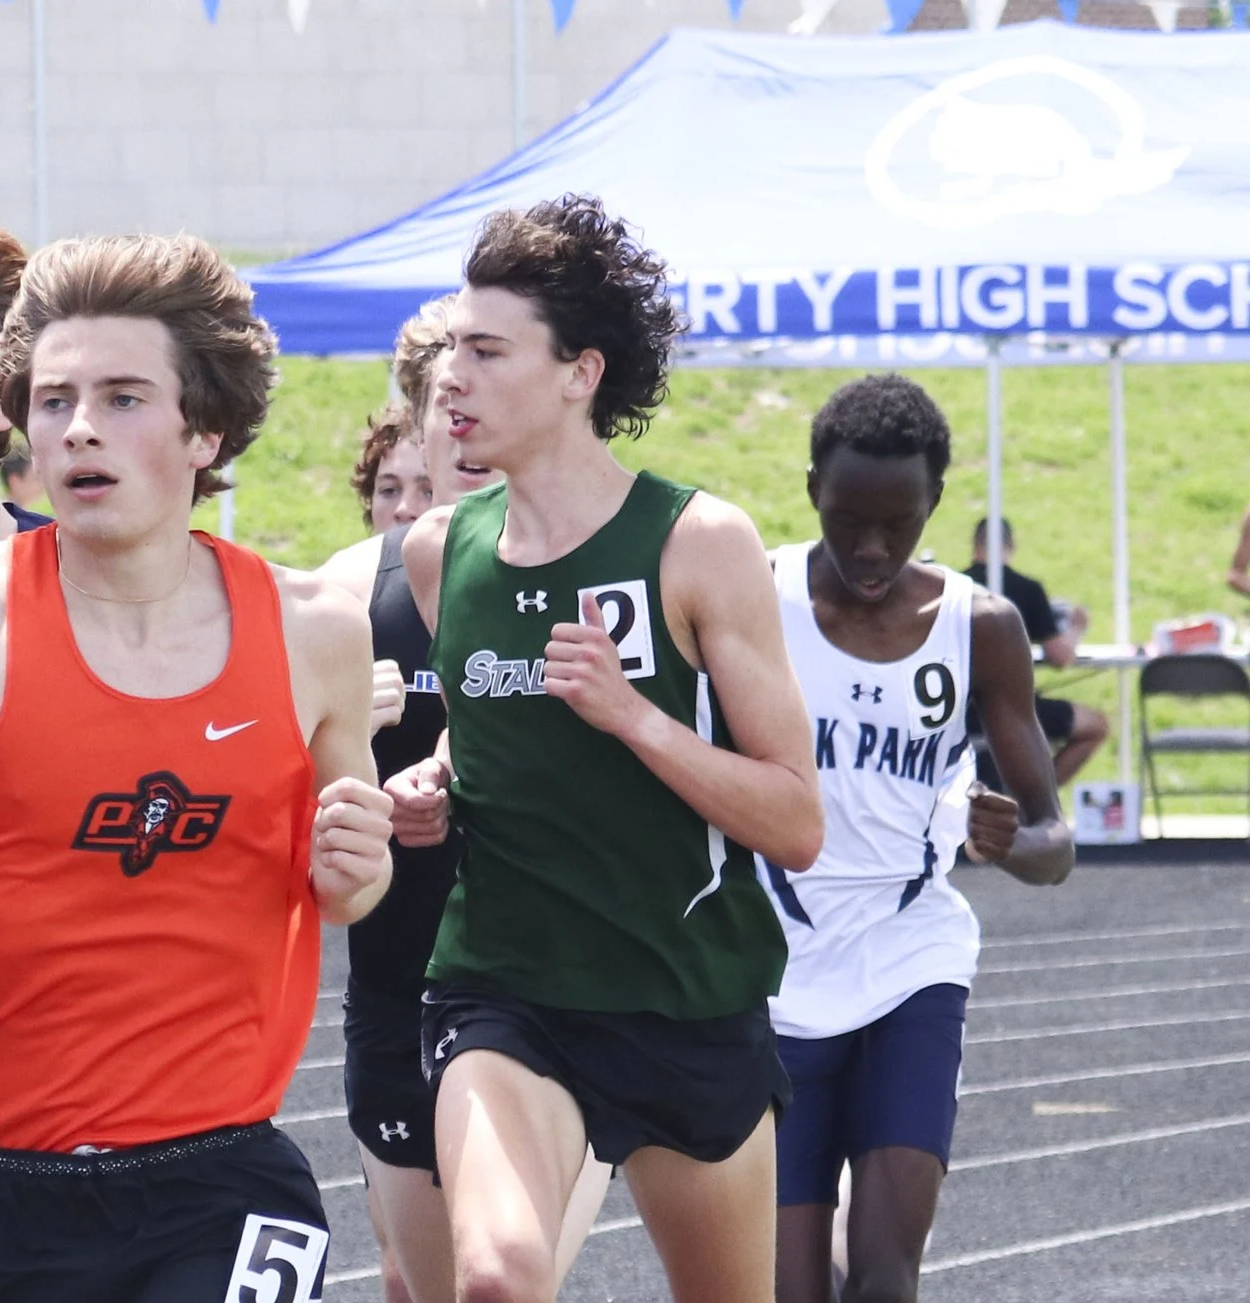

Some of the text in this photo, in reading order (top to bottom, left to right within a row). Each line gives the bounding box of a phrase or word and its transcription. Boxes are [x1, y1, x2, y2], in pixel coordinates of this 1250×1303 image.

[876, 263, 1089, 332] HIGH
[594, 590, 643, 672] 2
[913, 662, 957, 730] 9
[853, 721, 946, 788] PARK
